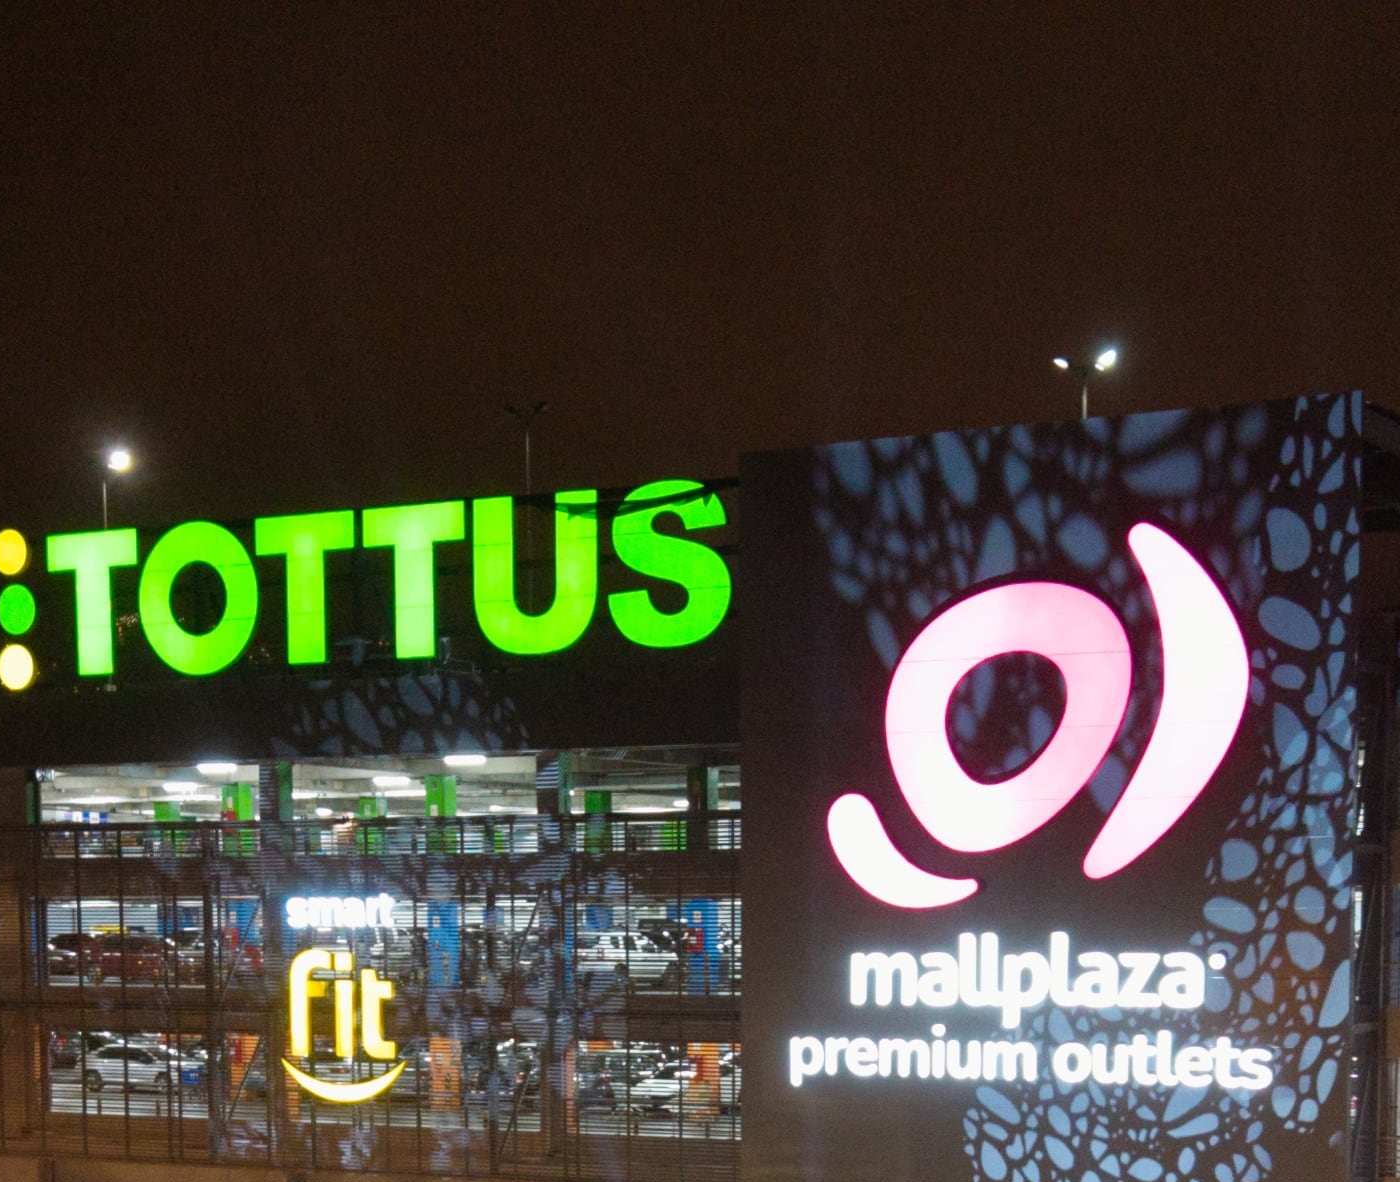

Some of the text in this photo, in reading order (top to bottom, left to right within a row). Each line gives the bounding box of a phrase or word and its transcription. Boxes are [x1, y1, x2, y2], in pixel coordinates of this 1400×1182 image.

[46, 479, 731, 676] TOTTUS
[286, 893, 395, 927] smart
[290, 949, 396, 1059] fit
[850, 931, 1206, 1028] mallplaza
[790, 1023, 1273, 1090] premium outlets
